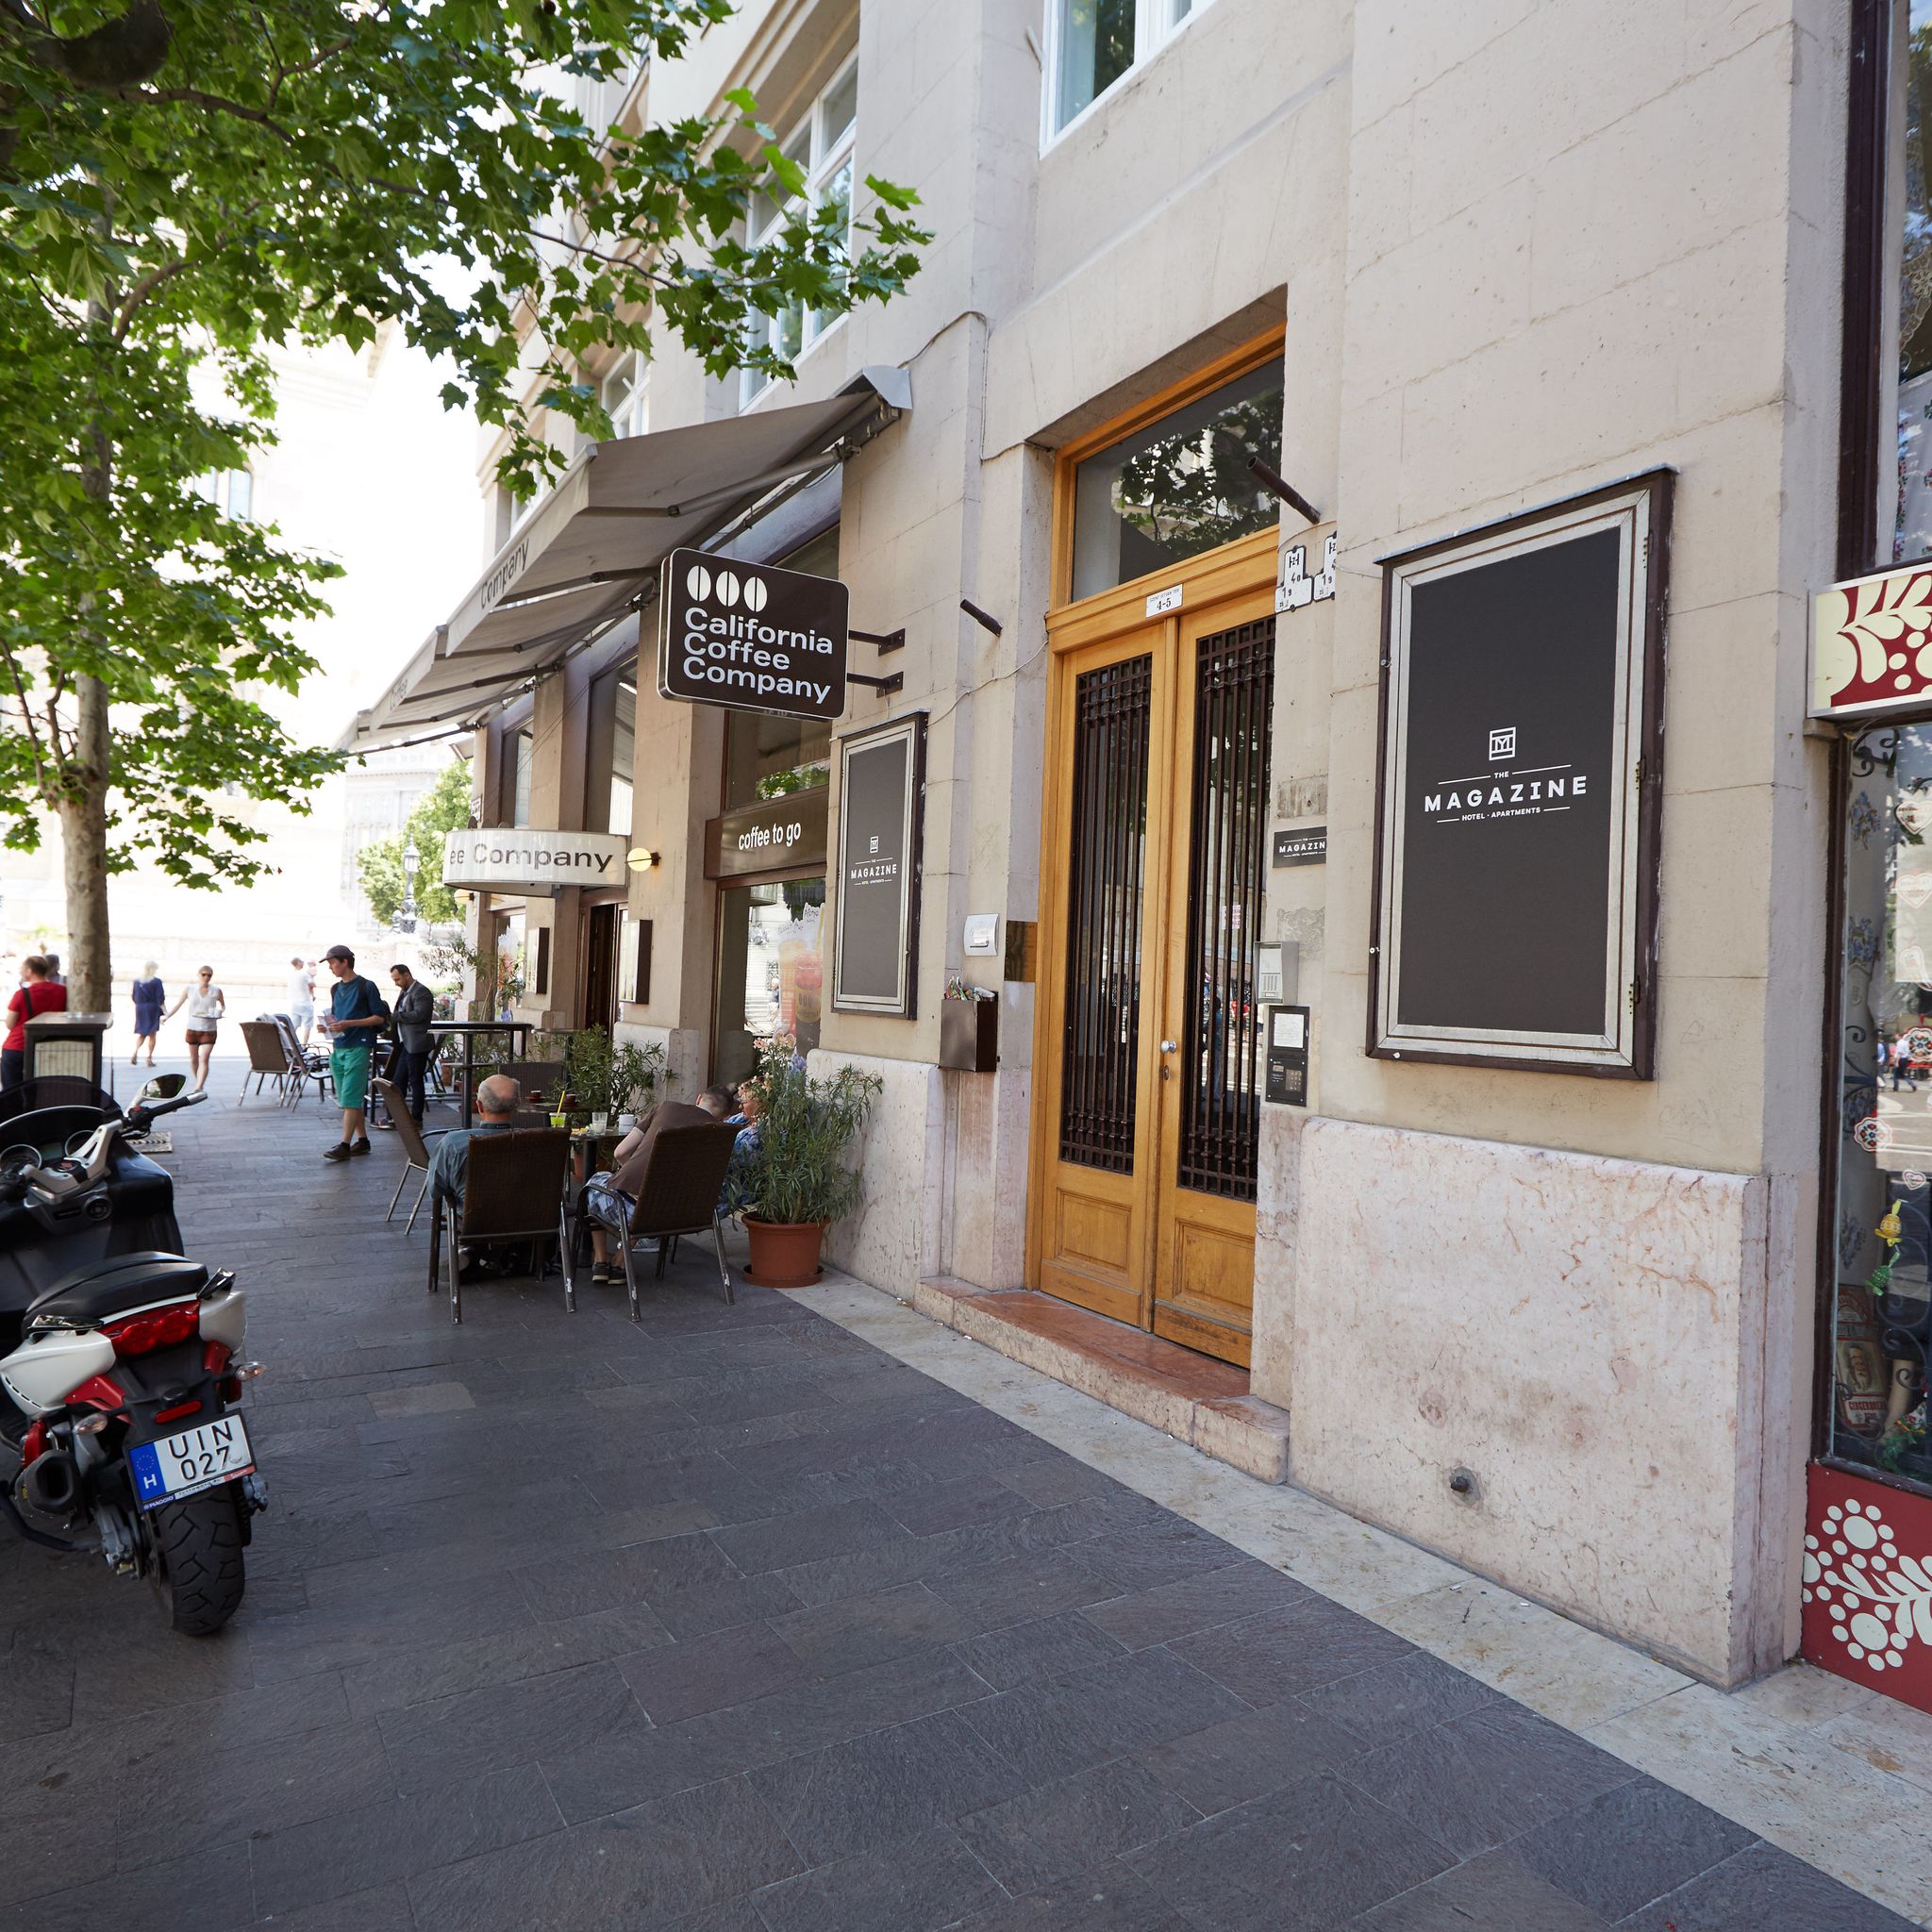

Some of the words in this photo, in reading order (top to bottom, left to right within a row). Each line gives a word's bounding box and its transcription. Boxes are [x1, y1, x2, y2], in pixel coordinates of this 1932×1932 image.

[479, 539, 530, 609] Company
[1157, 598, 1172, 609] 4-5
[685, 607, 833, 655] California
[683, 632, 791, 671] Coffee
[682, 656, 831, 705] Company
[1493, 771, 1509, 779] THE
[1424, 775, 1587, 812] MAGAZINE
[1462, 812, 1486, 822] HOTEL
[1491, 807, 1541, 818] APARTMENTS
[739, 825, 771, 850] coffee
[773, 823, 784, 844] to
[786, 822, 802, 847] go
[473, 842, 613, 874] Company
[850, 864, 897, 879] MAGAZINE
[168, 1421, 233, 1458] UIN
[180, 1445, 230, 1481] 027
[142, 1474, 158, 1490] H
[149, 1494, 174, 1507] PIAGGIO
